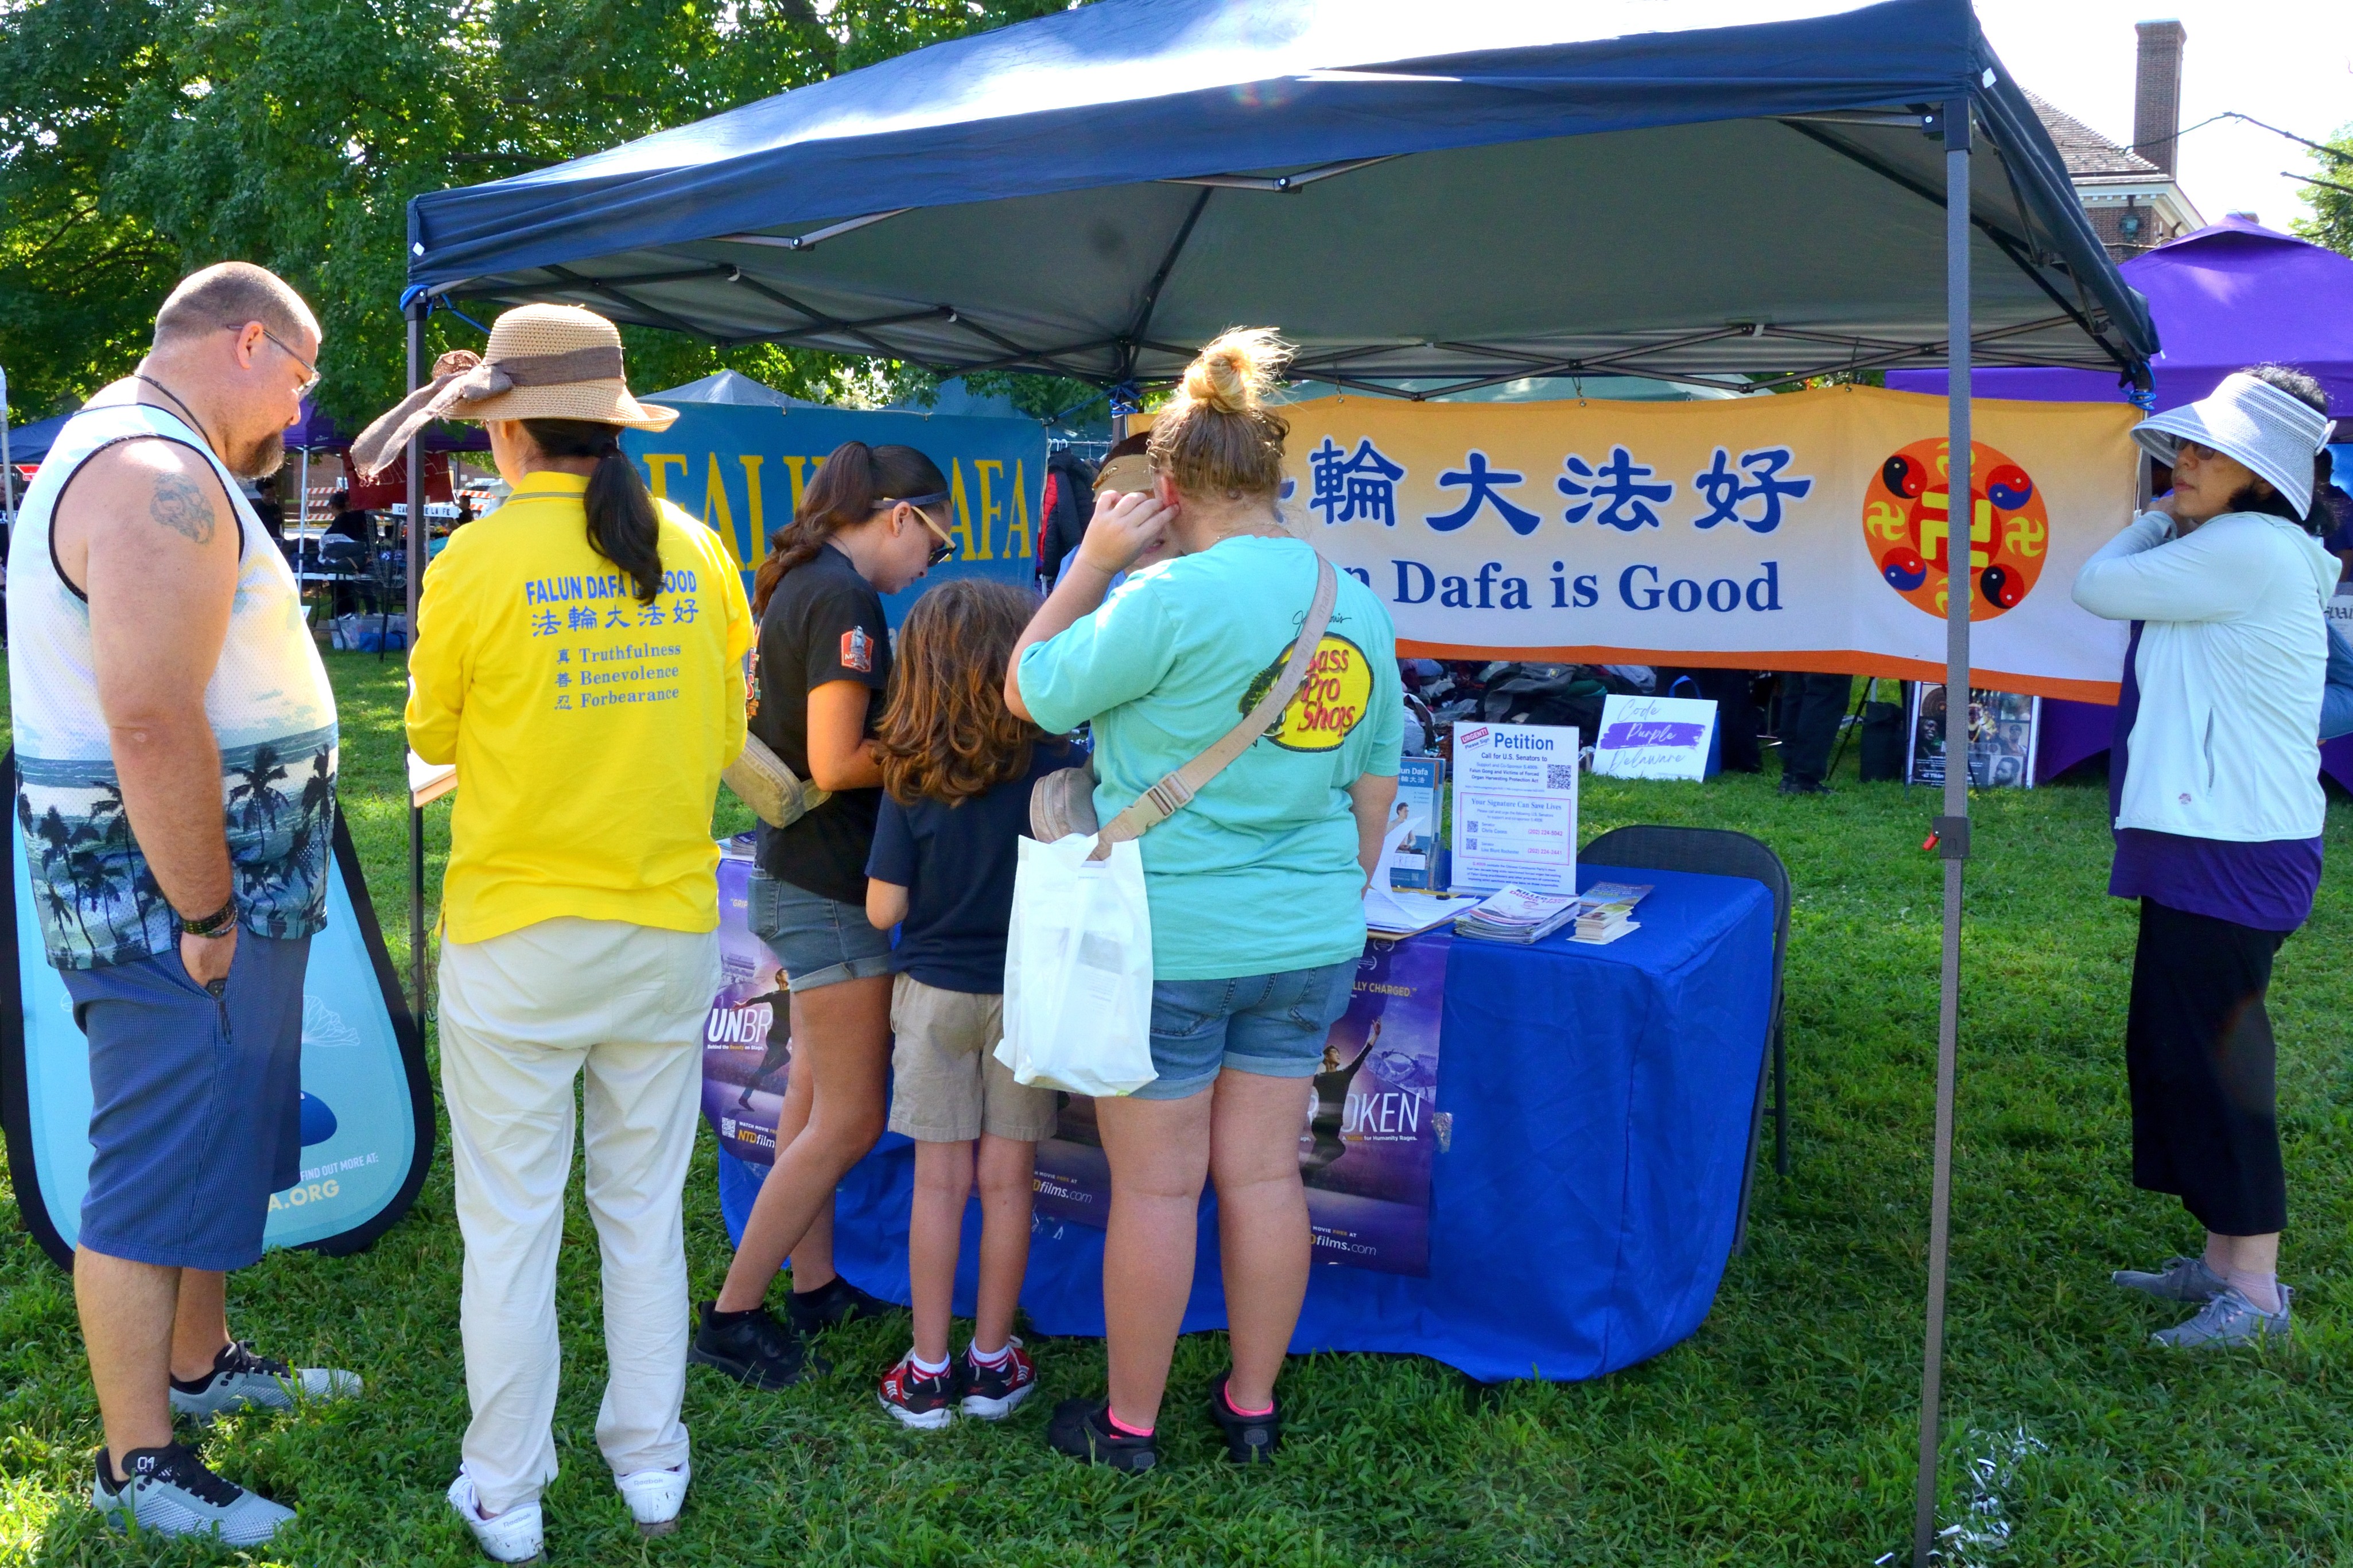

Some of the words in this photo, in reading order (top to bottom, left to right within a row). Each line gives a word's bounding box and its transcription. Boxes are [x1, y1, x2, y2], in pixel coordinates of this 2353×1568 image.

[1280, 437, 1811, 536] 輪大法好
[950, 457, 1032, 562] AFA
[526, 575, 583, 606] FALUN
[586, 574, 627, 599] DAFA
[657, 570, 697, 595] OOD
[1391, 560, 1532, 610] Dafa
[1551, 561, 1599, 609] is
[1618, 561, 1783, 613] Good
[531, 598, 699, 637] 法輪大法好
[557, 649, 570, 665] 真
[579, 643, 681, 663] Truthfulness
[554, 672, 572, 688] 善
[580, 666, 679, 686] Benevolence
[1302, 672, 1340, 702] Pro
[580, 688, 679, 708] Forbearance
[1297, 701, 1356, 737] Shops
[1617, 699, 1661, 722] Code
[1462, 728, 1488, 742] URGENT!
[1494, 732, 1554, 750] Petition
[1626, 723, 1677, 744] Purple
[1609, 748, 1686, 772] Delaware
[1400, 776, 1426, 784] 輪大法
[1412, 767, 1428, 776] Dafa
[1488, 799, 1516, 807] Signature
[1353, 981, 1368, 991] LLY
[708, 1008, 772, 1042] UNBR
[739, 1120, 754, 1129] WATCH
[738, 1129, 775, 1149] NTDfilm
[300, 1167, 320, 1182] FIND
[321, 1162, 338, 1176] OUT
[340, 1155, 364, 1172] MORE
[367, 1152, 379, 1165] AT:
[268, 1179, 340, 1212] A.ORG
[1033, 1179, 1093, 1204] Dfilms.com
[1313, 1225, 1331, 1234] MOVIE
[634, 1477, 663, 1487] Reebok
[503, 1512, 531, 1528] Reebok
